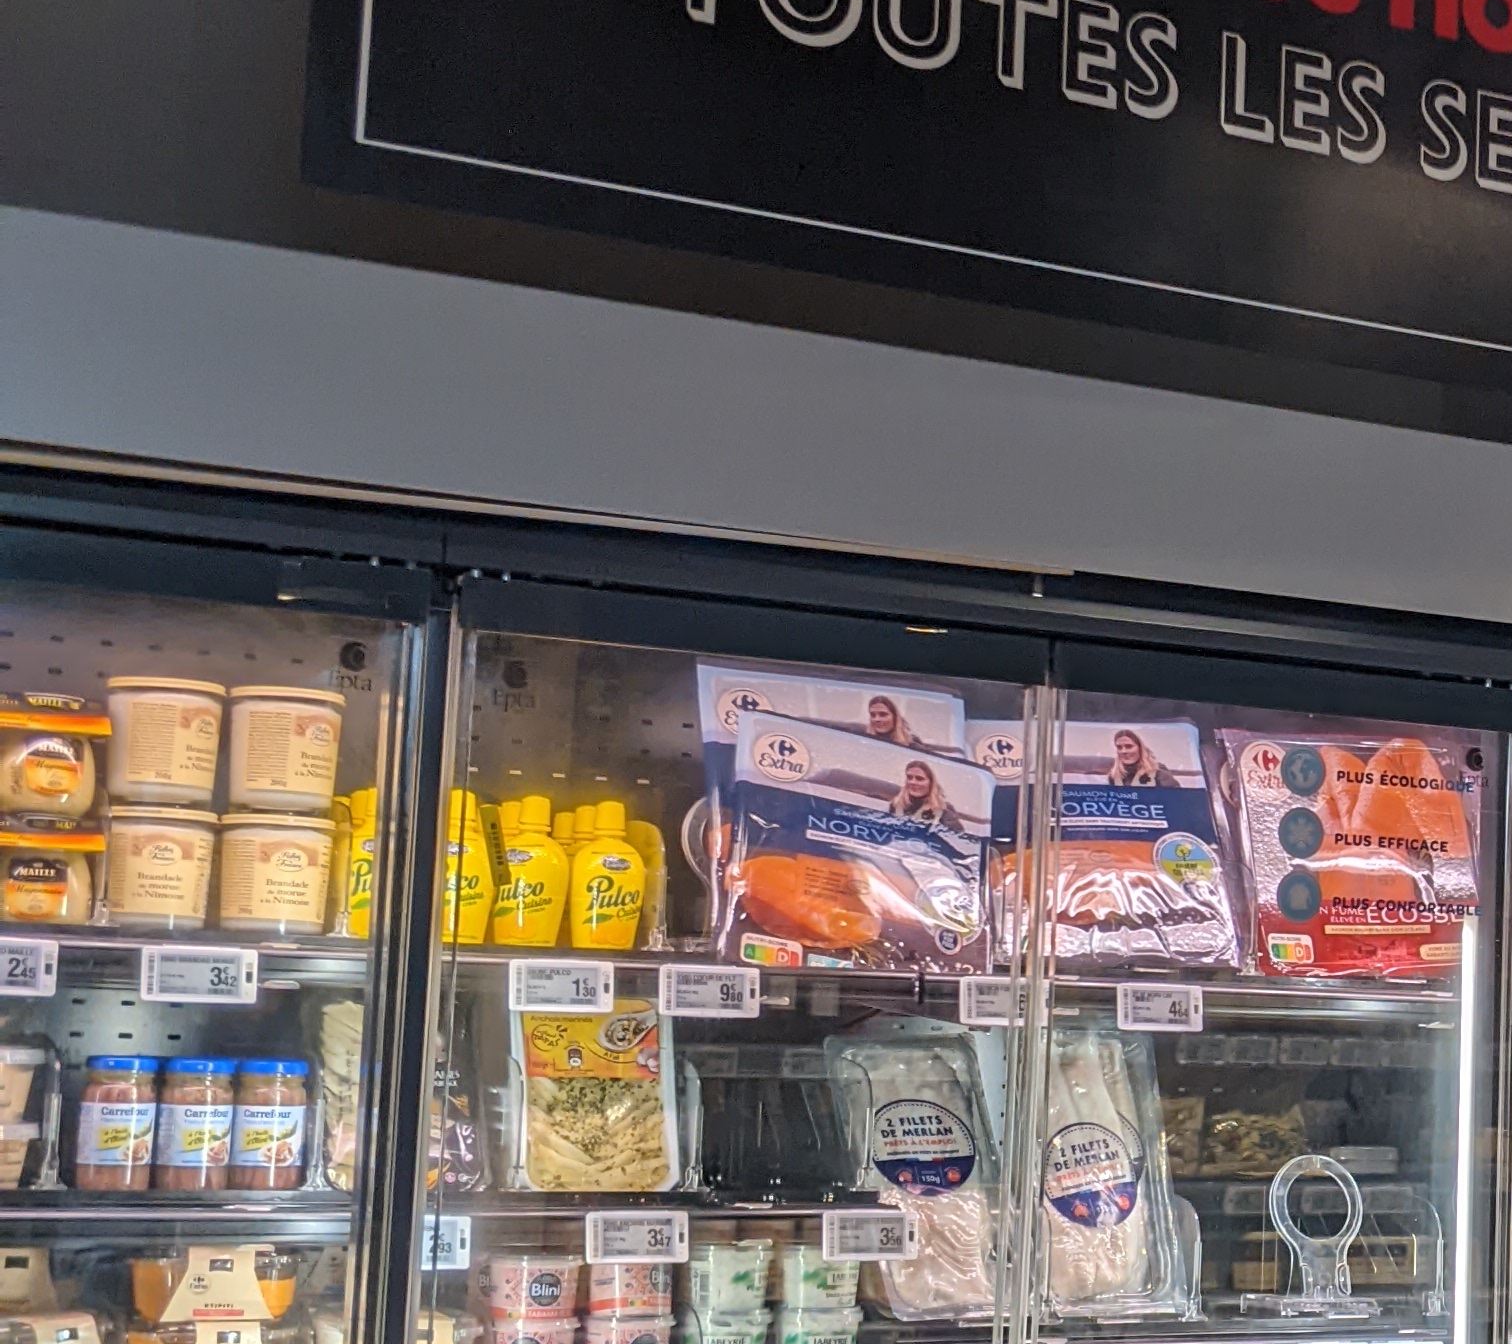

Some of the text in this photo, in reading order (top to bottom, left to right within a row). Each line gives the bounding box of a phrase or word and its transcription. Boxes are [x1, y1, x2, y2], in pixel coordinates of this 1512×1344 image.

[1220, 29, 1387, 166] LES
[759, 752, 806, 774] Extra
[982, 755, 1024, 768] Extra
[1336, 769, 1475, 794] PLUS ÉCOLOGIQUE
[1334, 833, 1449, 853] PLUS EFFICACE
[586, 875, 641, 912] Pulco
[1332, 896, 1482, 917] PLUS CONFORTABLE
[572, 977, 597, 998] 1€30
[886, 1115, 943, 1127] 2 FILETS
[881, 1127, 954, 1138] DE MERLAN
[1060, 1138, 1110, 1157] 2 FILETS
[1054, 1161, 1071, 1172] DE
